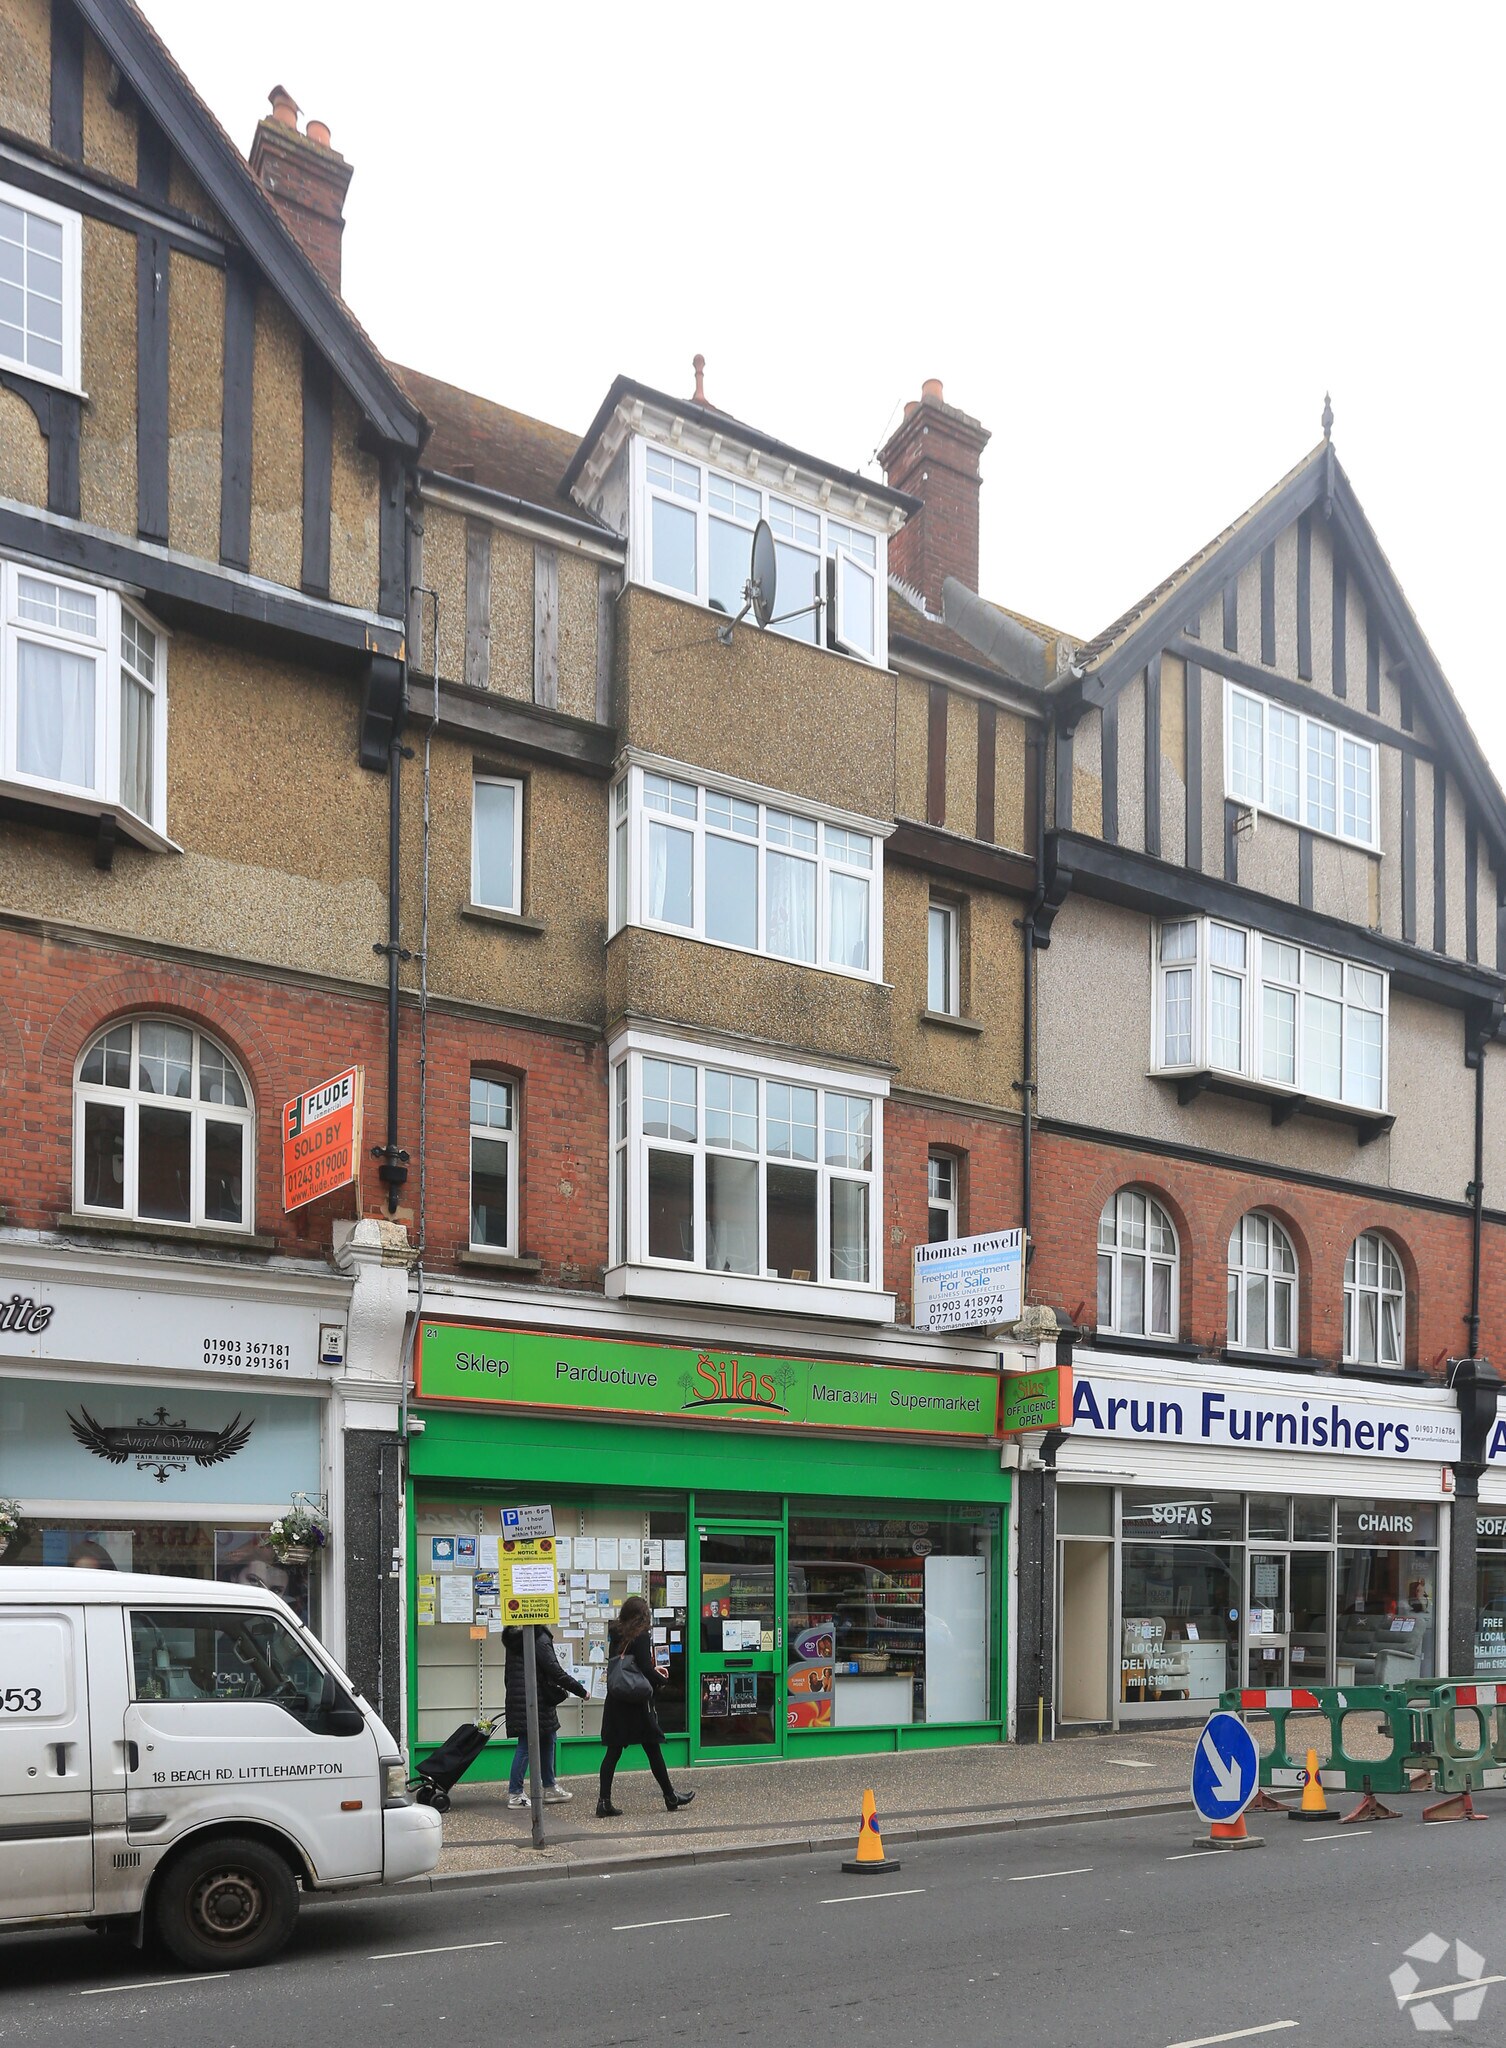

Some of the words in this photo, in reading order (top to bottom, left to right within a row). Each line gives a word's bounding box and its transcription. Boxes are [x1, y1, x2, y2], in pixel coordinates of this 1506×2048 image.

[308, 1079, 349, 1114] FLUDE
[314, 1101, 342, 1120] commercial
[294, 1131, 322, 1160] SOLD
[326, 1122, 342, 1145] BY
[288, 1165, 312, 1192] 01243
[315, 1148, 348, 1179] 819000
[290, 1171, 345, 1204] www.flude.com
[916, 1245, 967, 1262] thomas
[973, 1231, 1020, 1253] newell
[922, 1270, 959, 1283] Freehold
[961, 1264, 1010, 1277] Investment
[940, 1280, 960, 1291] For
[964, 1274, 990, 1289] Sale
[928, 1291, 960, 1300] BUSINESS
[961, 1285, 1006, 1296] UNAFFECTED
[929, 1300, 961, 1313] 01903
[964, 1294, 1004, 1308] 418974
[929, 1311, 961, 1325] 07710
[965, 1306, 1003, 1320] 123999
[935, 1317, 997, 1331] thomasnewell.co.uk
[426, 1329, 438, 1338] 21
[203, 1338, 241, 1352] 01903
[246, 1342, 290, 1356] 367181
[203, 1353, 241, 1366] 07950
[245, 1356, 289, 1370] 291361
[455, 1352, 510, 1377] Sklep
[555, 1361, 658, 1387] Parduotuve
[692, 1353, 776, 1403] Šilas
[812, 1384, 878, 1404] Магазин
[889, 1390, 981, 1412] Supermarket
[1006, 1406, 1021, 1416] OFF
[1022, 1400, 1056, 1414] LICENCE
[1073, 1380, 1183, 1435] Arun
[1201, 1392, 1410, 1453] Furnishers
[1019, 1414, 1043, 1427] OPEN
[1415, 1425, 1433, 1434] 01903
[1435, 1427, 1456, 1435] 716784
[115, 1432, 159, 1451] Angel
[162, 1434, 210, 1449] White
[1151, 1505, 1212, 1526] SOFAS
[1358, 1514, 1413, 1532] CHAIRS
[1134, 1626, 1162, 1637] FEE
[1482, 1618, 1503, 1627] FREE
[1480, 1632, 1505, 1641] LOCAL
[1131, 1643, 1165, 1653] LOCAL
[1122, 1658, 1174, 1670] DELIVERY
[1477, 1660, 1491, 1669] min
[709, 1683, 722, 1692] 60
[1128, 1673, 1147, 1686] min
[1148, 1675, 1169, 1686] £150
[0, 1688, 42, 1712] 53
[152, 1771, 166, 1783] 18
[171, 1770, 211, 1782] BEACH
[216, 1768, 235, 1780] RD.
[238, 1763, 343, 1779] LITTLEHAMPTON
